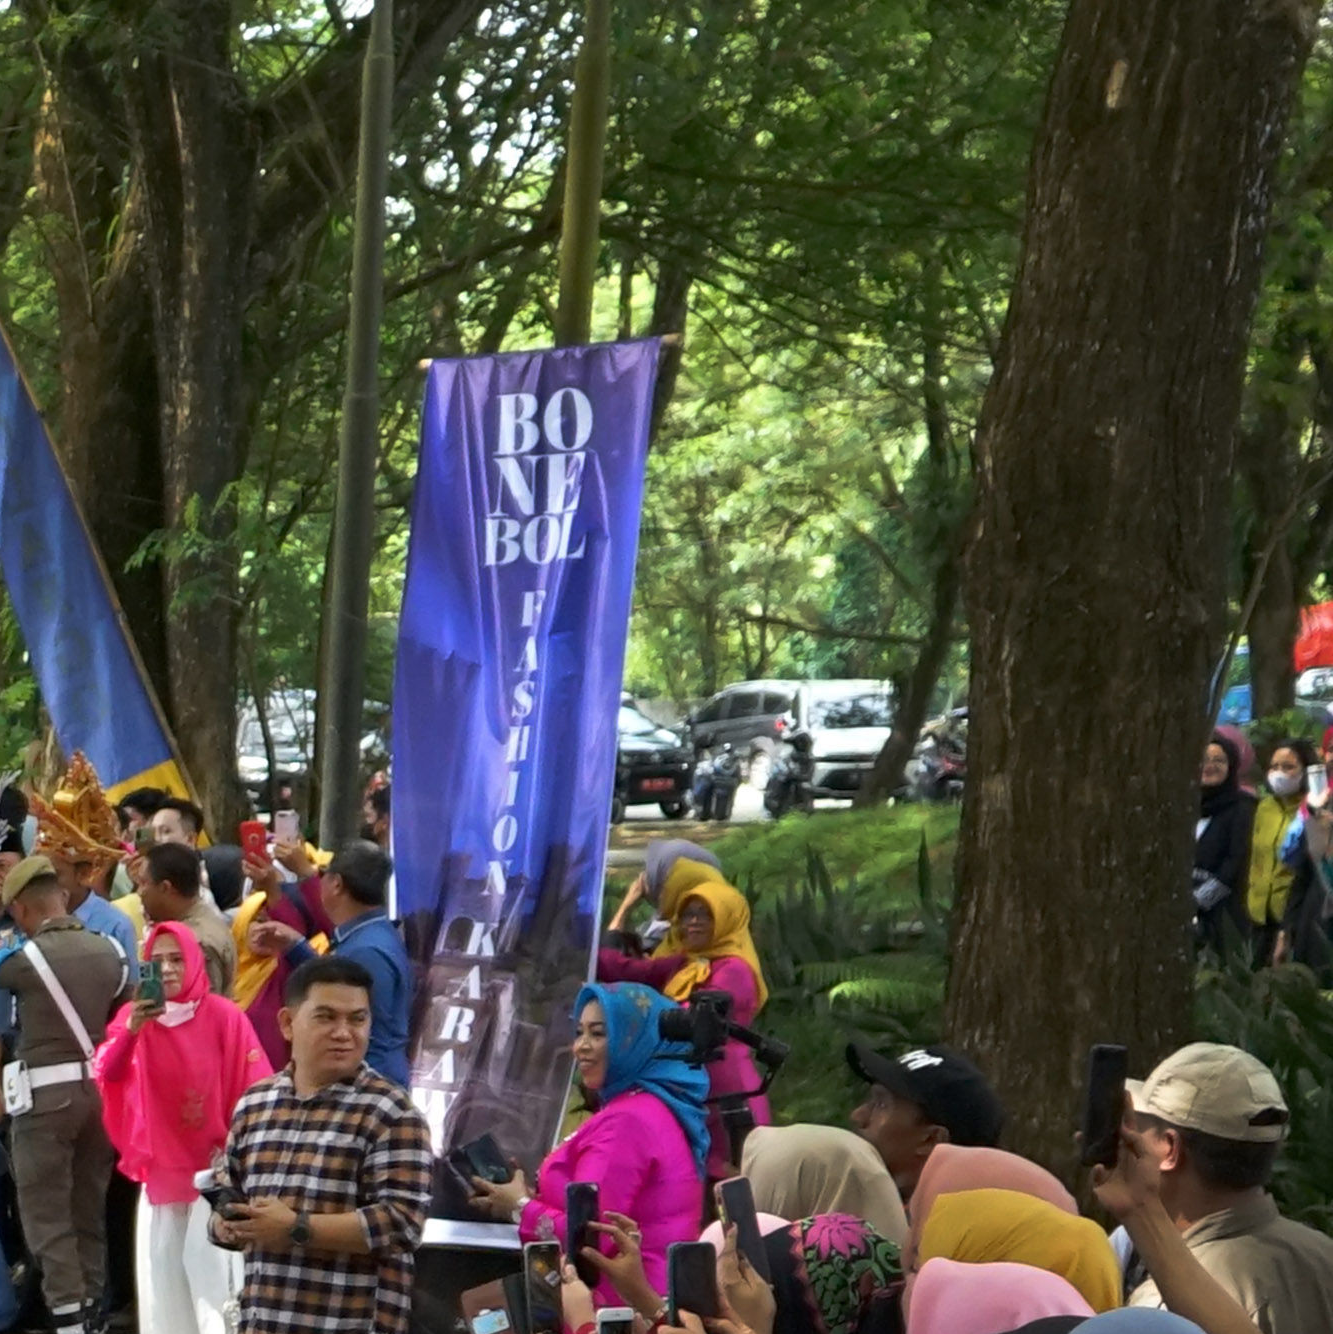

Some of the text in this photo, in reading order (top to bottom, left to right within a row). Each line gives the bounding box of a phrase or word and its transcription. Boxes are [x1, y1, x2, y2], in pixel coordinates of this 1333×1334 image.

[493, 387, 593, 456] BO
[487, 451, 585, 517] NE
[484, 513, 587, 566] BOL
[480, 589, 546, 896] FASHION
[411, 921, 499, 1155] KARAW
